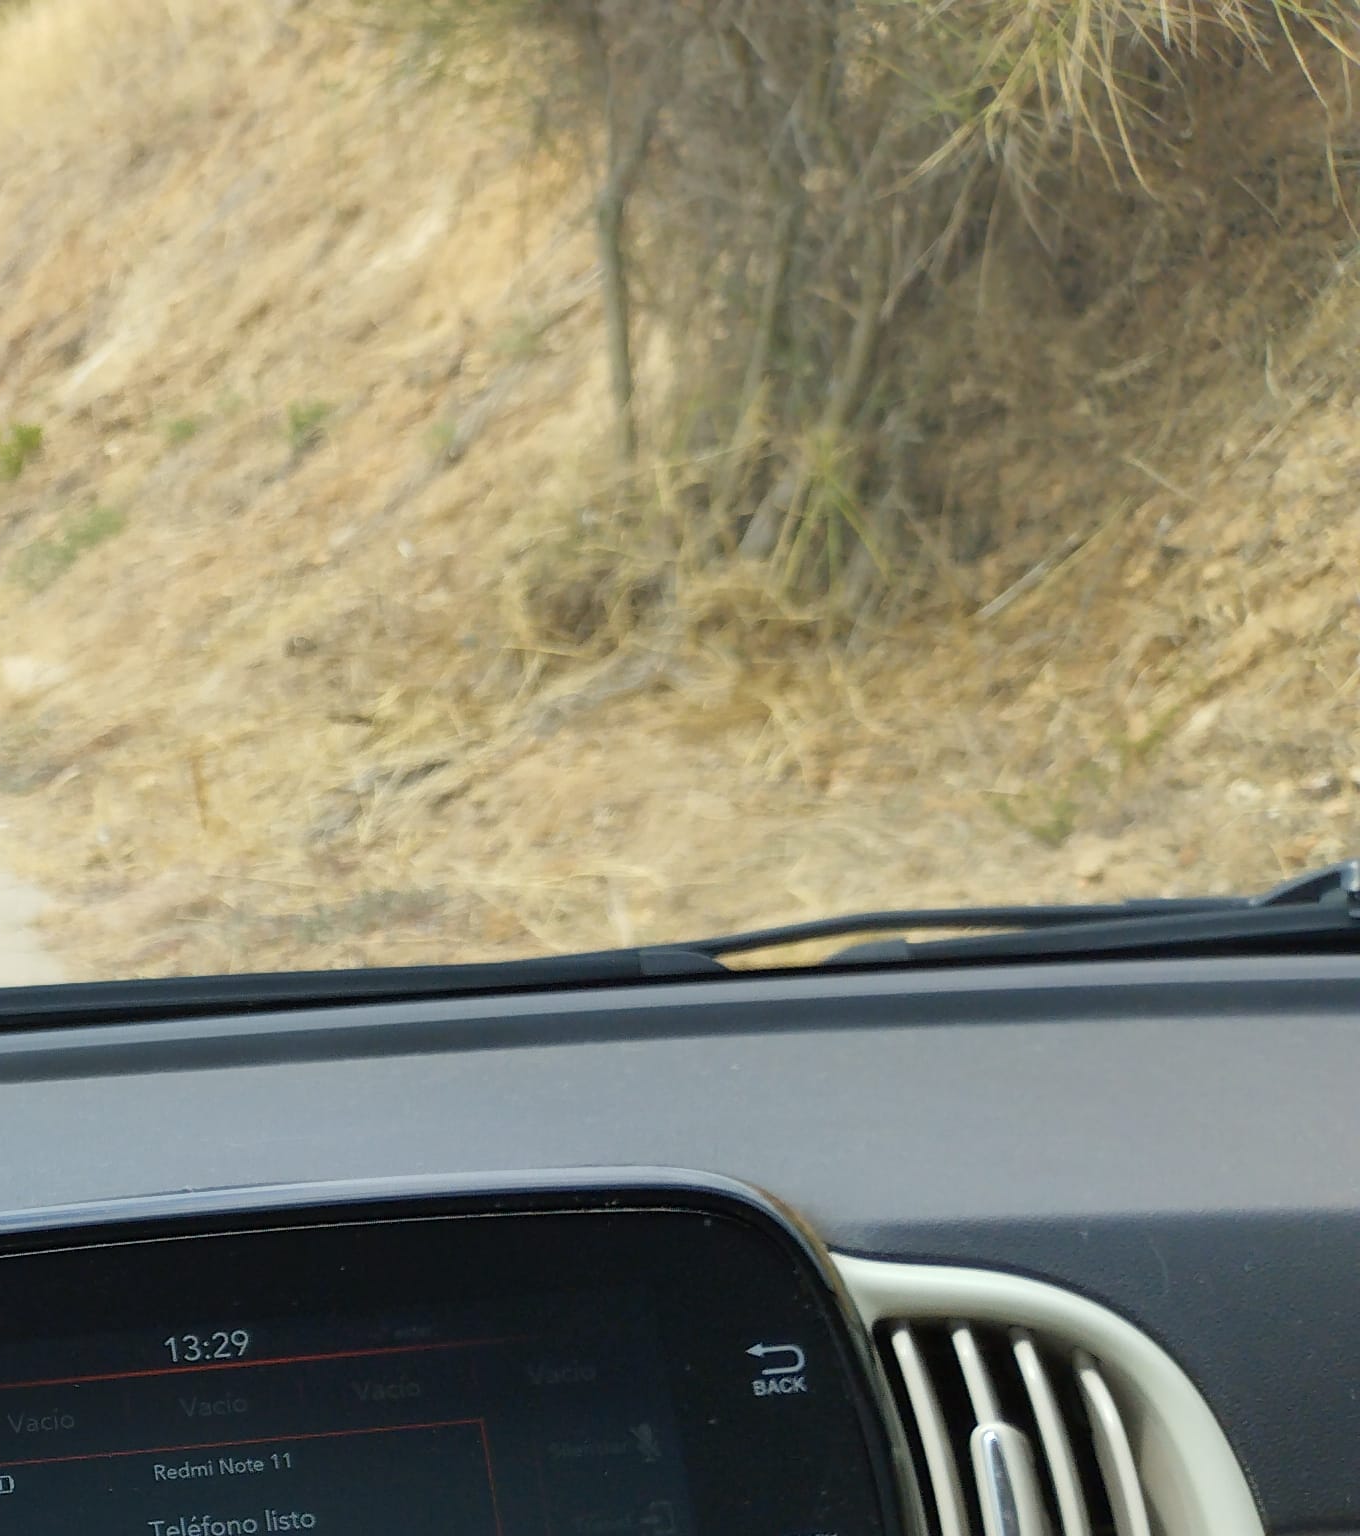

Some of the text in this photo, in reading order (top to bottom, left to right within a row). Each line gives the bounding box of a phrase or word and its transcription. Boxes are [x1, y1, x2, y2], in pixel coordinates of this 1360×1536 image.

[164, 1330, 249, 1364] 13:29
[752, 1376, 807, 1396] BACK
[153, 1453, 292, 1482] Redmi Note 11
[265, 1508, 316, 1533] listo
